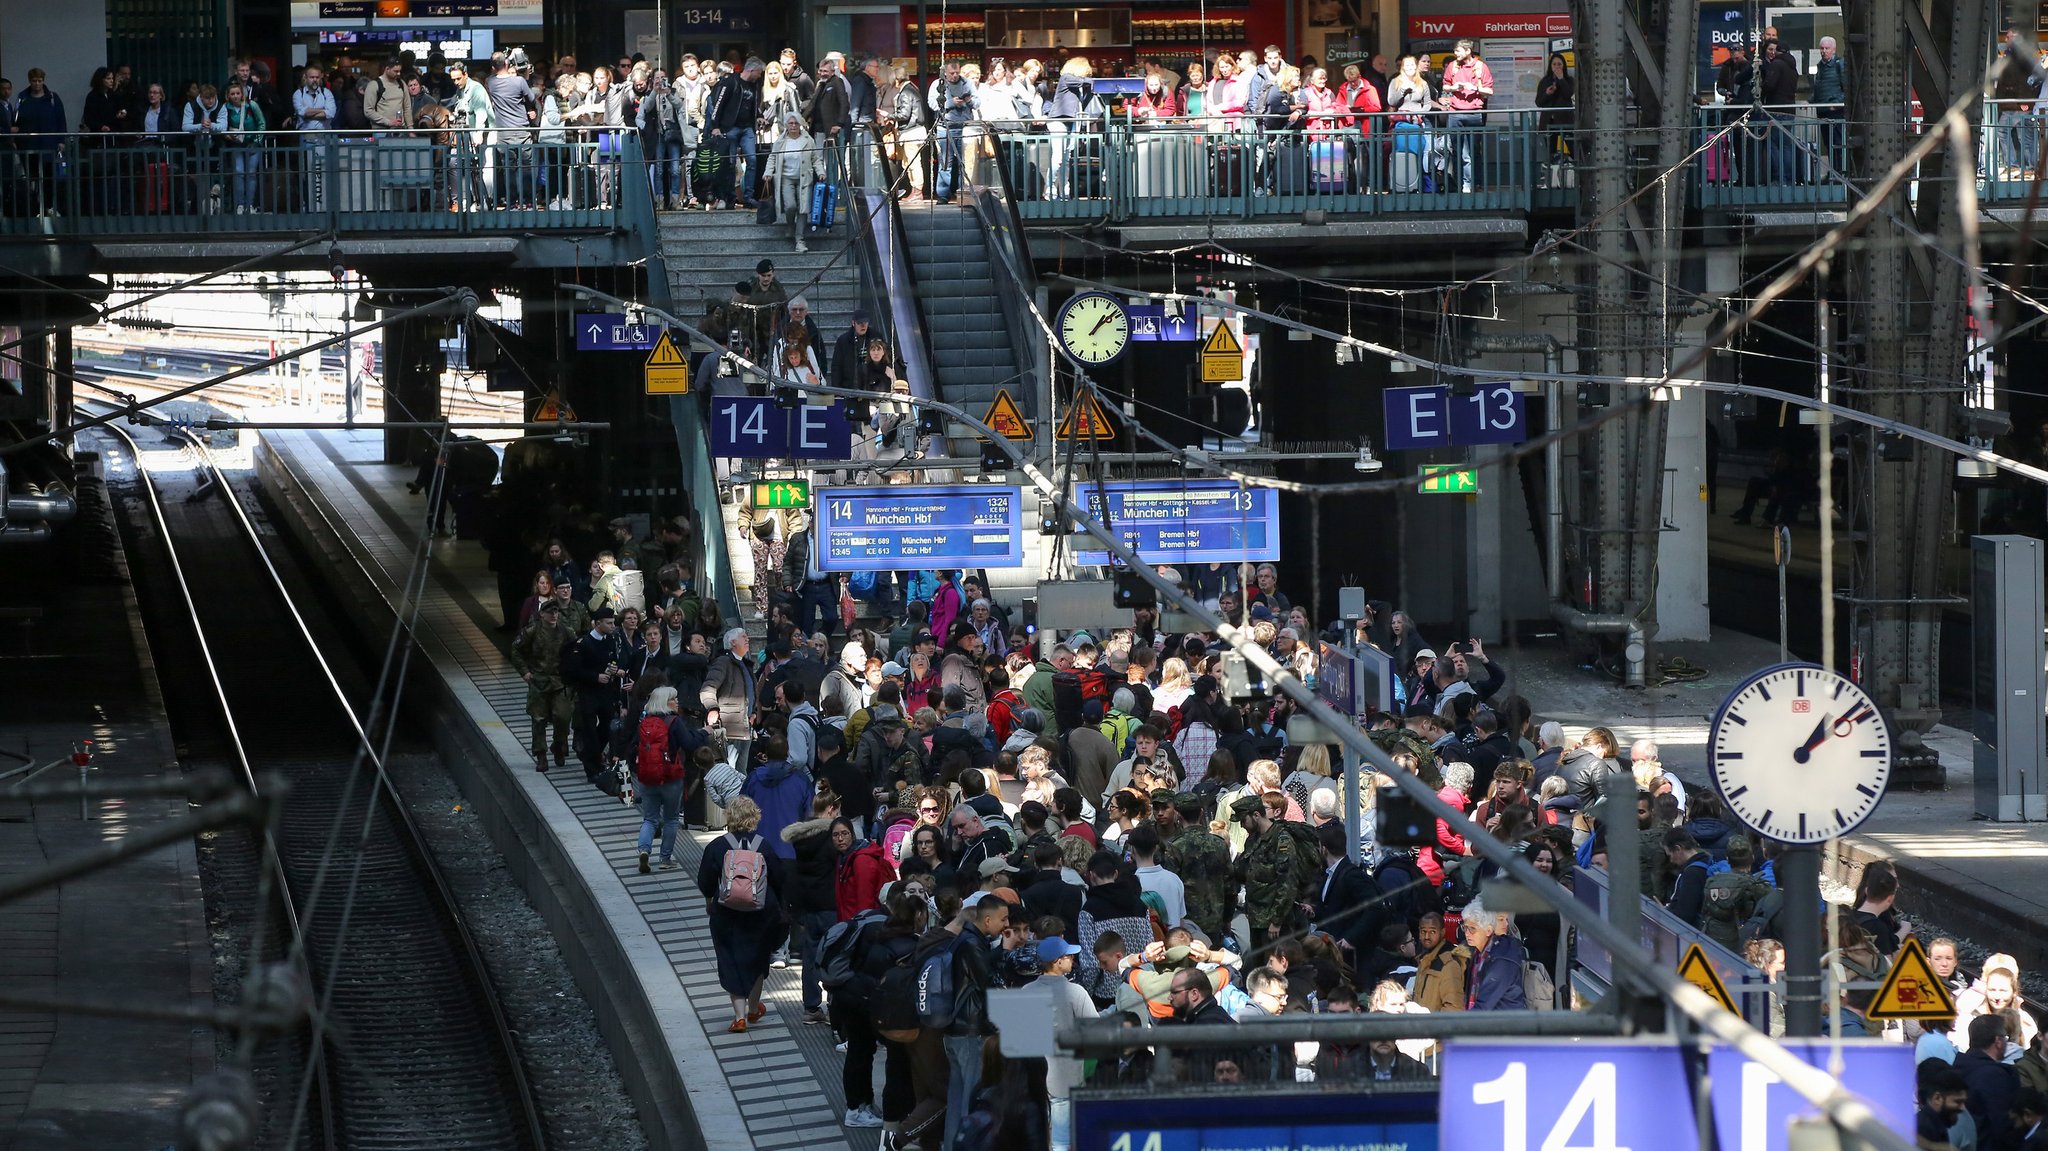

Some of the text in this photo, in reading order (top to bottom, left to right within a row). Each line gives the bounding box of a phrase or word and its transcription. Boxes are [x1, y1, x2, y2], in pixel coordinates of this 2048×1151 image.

[684, 9, 722, 24] 13-14
[1422, 20, 1454, 33] hvv
[1485, 22, 1541, 32] Fahrkarten
[1326, 49, 1369, 61] Ernesto
[1409, 388, 1517, 438] E 13
[721, 403, 828, 448] 14 E
[986, 497, 1008, 507] 13:24
[1231, 491, 1253, 511] 13
[830, 500, 853, 520] 14
[1123, 508, 1169, 519] München
[1172, 507, 1190, 518] Hbf
[865, 512, 932, 524] München Hbf
[1159, 531, 1185, 539] Bremen
[1187, 530, 1200, 538] Hbf
[831, 538, 850, 546] 13:01
[901, 537, 932, 545] München
[933, 536, 947, 544] Hbf
[1159, 540, 1186, 549] Bremen
[1187, 540, 1200, 548] Hbf
[831, 548, 851, 556] 13:45
[866, 547, 876, 555] ICE
[1794, 702, 1809, 711] DB
[1473, 1061, 1633, 1151] 14
